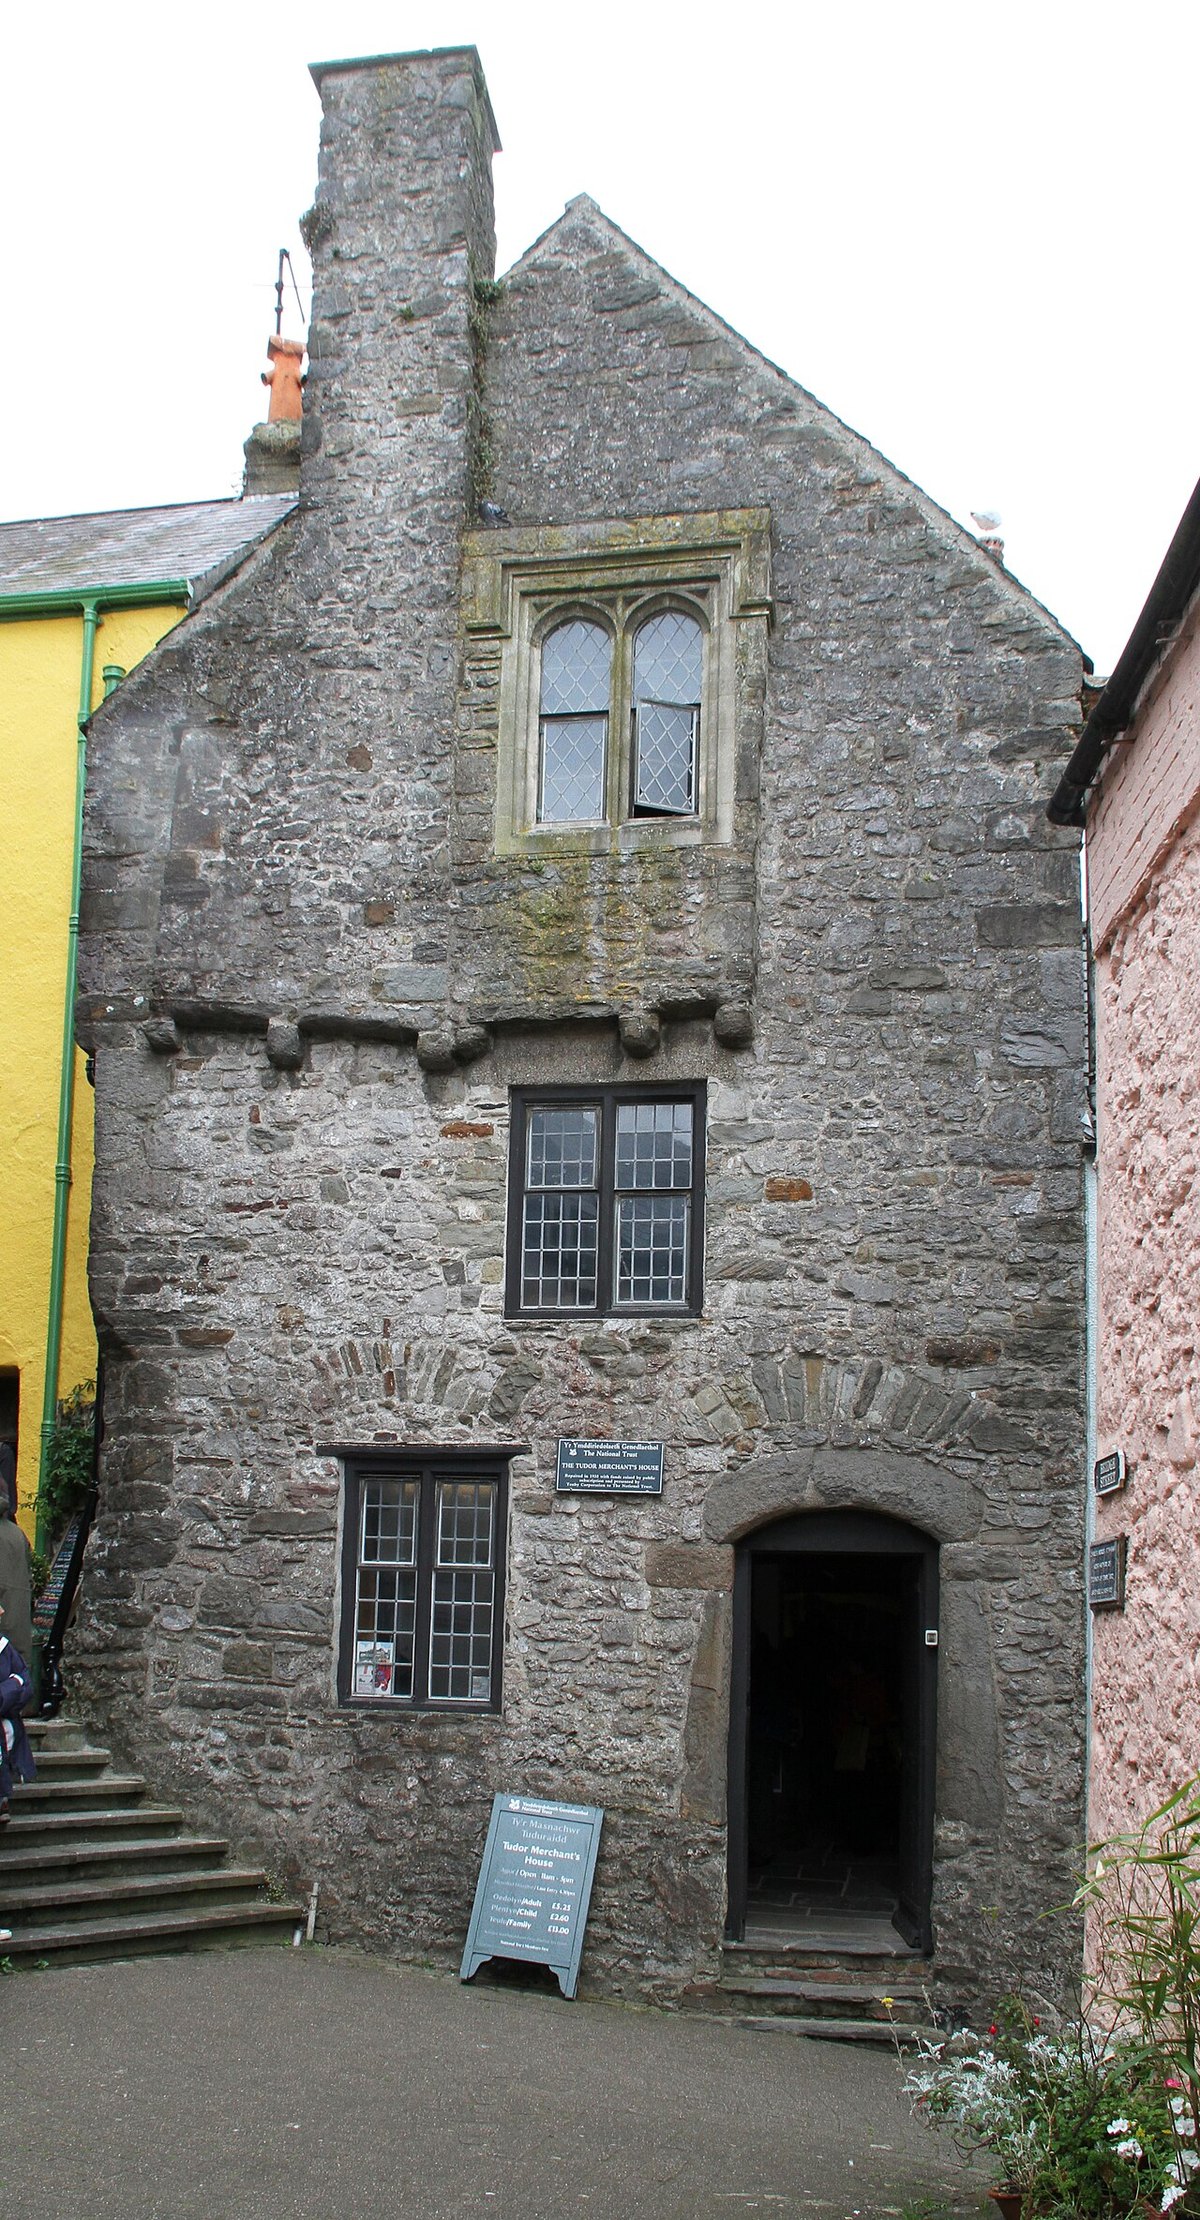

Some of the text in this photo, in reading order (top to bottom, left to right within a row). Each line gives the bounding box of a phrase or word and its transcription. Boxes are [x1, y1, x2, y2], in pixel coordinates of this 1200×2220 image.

[529, 1820, 580, 1834] Masnachwr
[522, 1830, 567, 1844] Tuduraidd
[503, 1841, 580, 1861] Tudor Merchant's
[525, 1856, 554, 1868] House
[520, 1869, 537, 1878] Open
[541, 1873, 555, 1881] 11am
[561, 1875, 574, 1884] 5pm
[551, 1902, 571, 1911] £5.25
[550, 1913, 569, 1922] £2.60
[548, 1925, 570, 1935] £13.00
